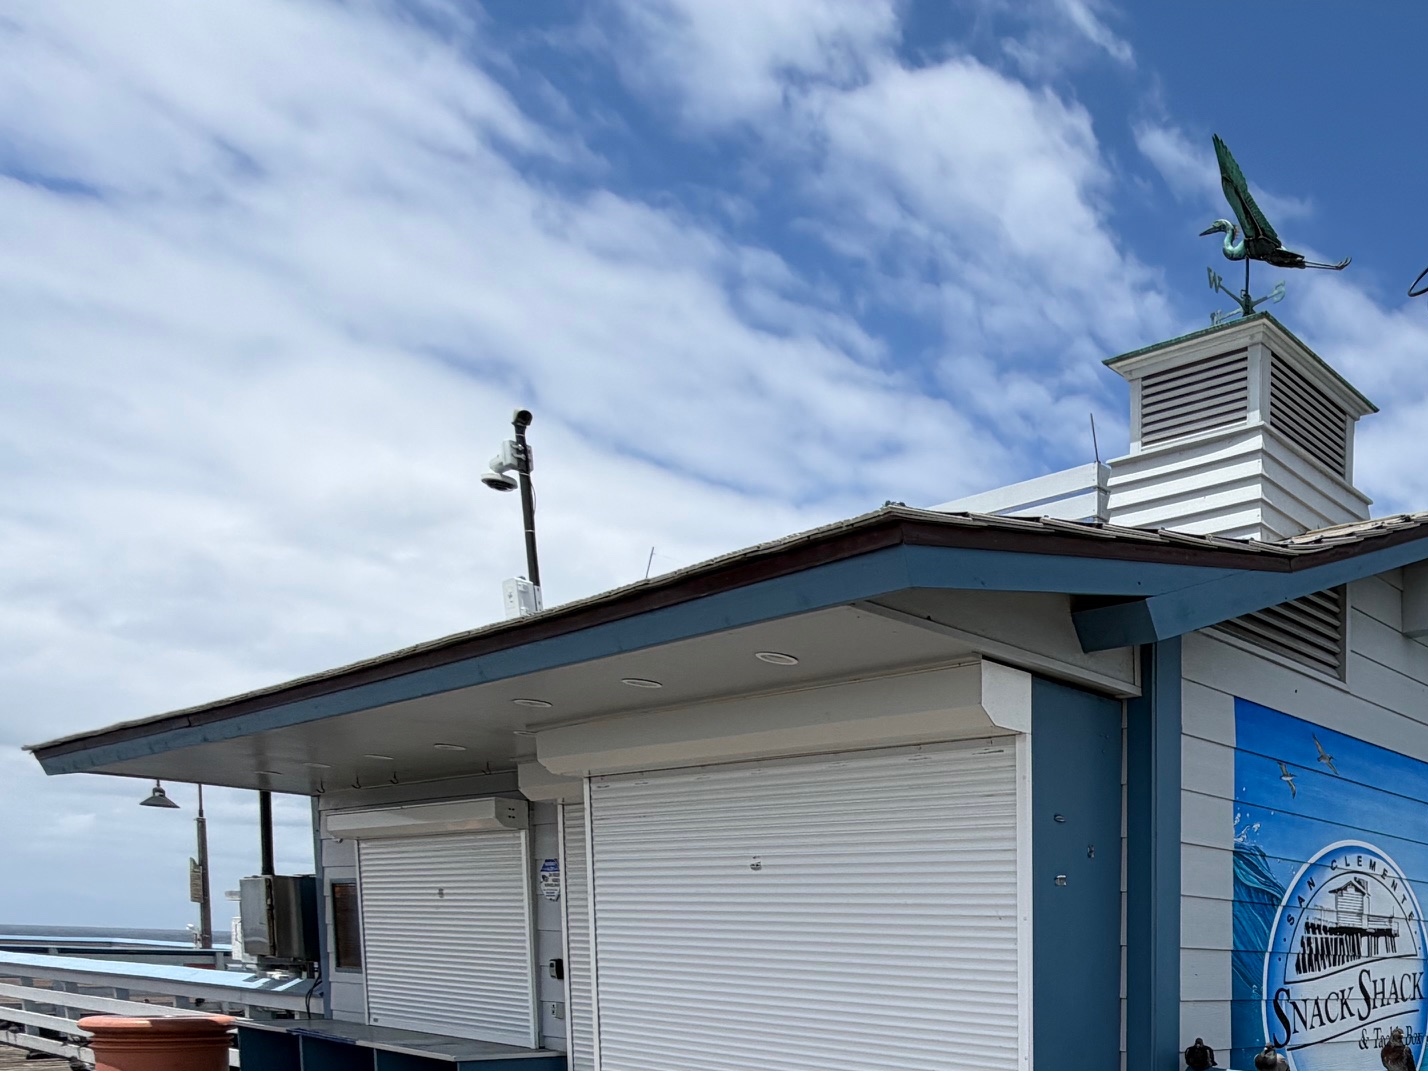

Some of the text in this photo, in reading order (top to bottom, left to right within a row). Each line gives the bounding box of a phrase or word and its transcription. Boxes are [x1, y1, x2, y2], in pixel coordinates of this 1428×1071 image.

[1287, 855, 1415, 926] SAN CLEMENTE
[1272, 969, 1425, 1049] SNACK SHACK
[1358, 1028, 1370, 1050] &
[1405, 1025, 1424, 1046] Box
